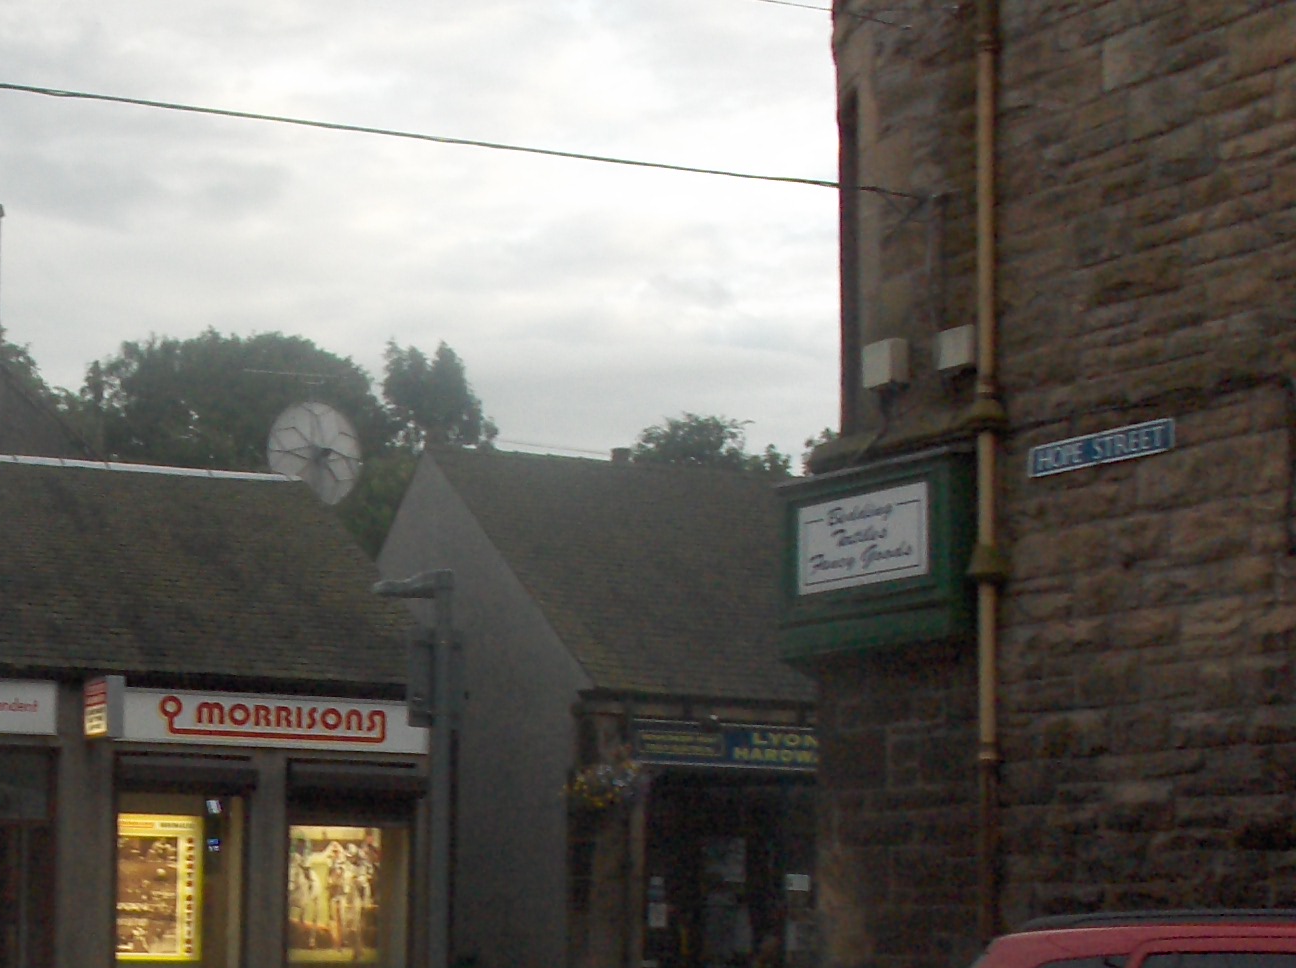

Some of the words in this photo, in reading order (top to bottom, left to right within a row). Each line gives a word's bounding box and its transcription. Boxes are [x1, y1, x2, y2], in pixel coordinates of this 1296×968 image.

[1036, 441, 1083, 471] HOPE
[1091, 425, 1166, 459] STREET
[860, 543, 913, 569] Goods
[195, 699, 387, 740] MORRISONS
